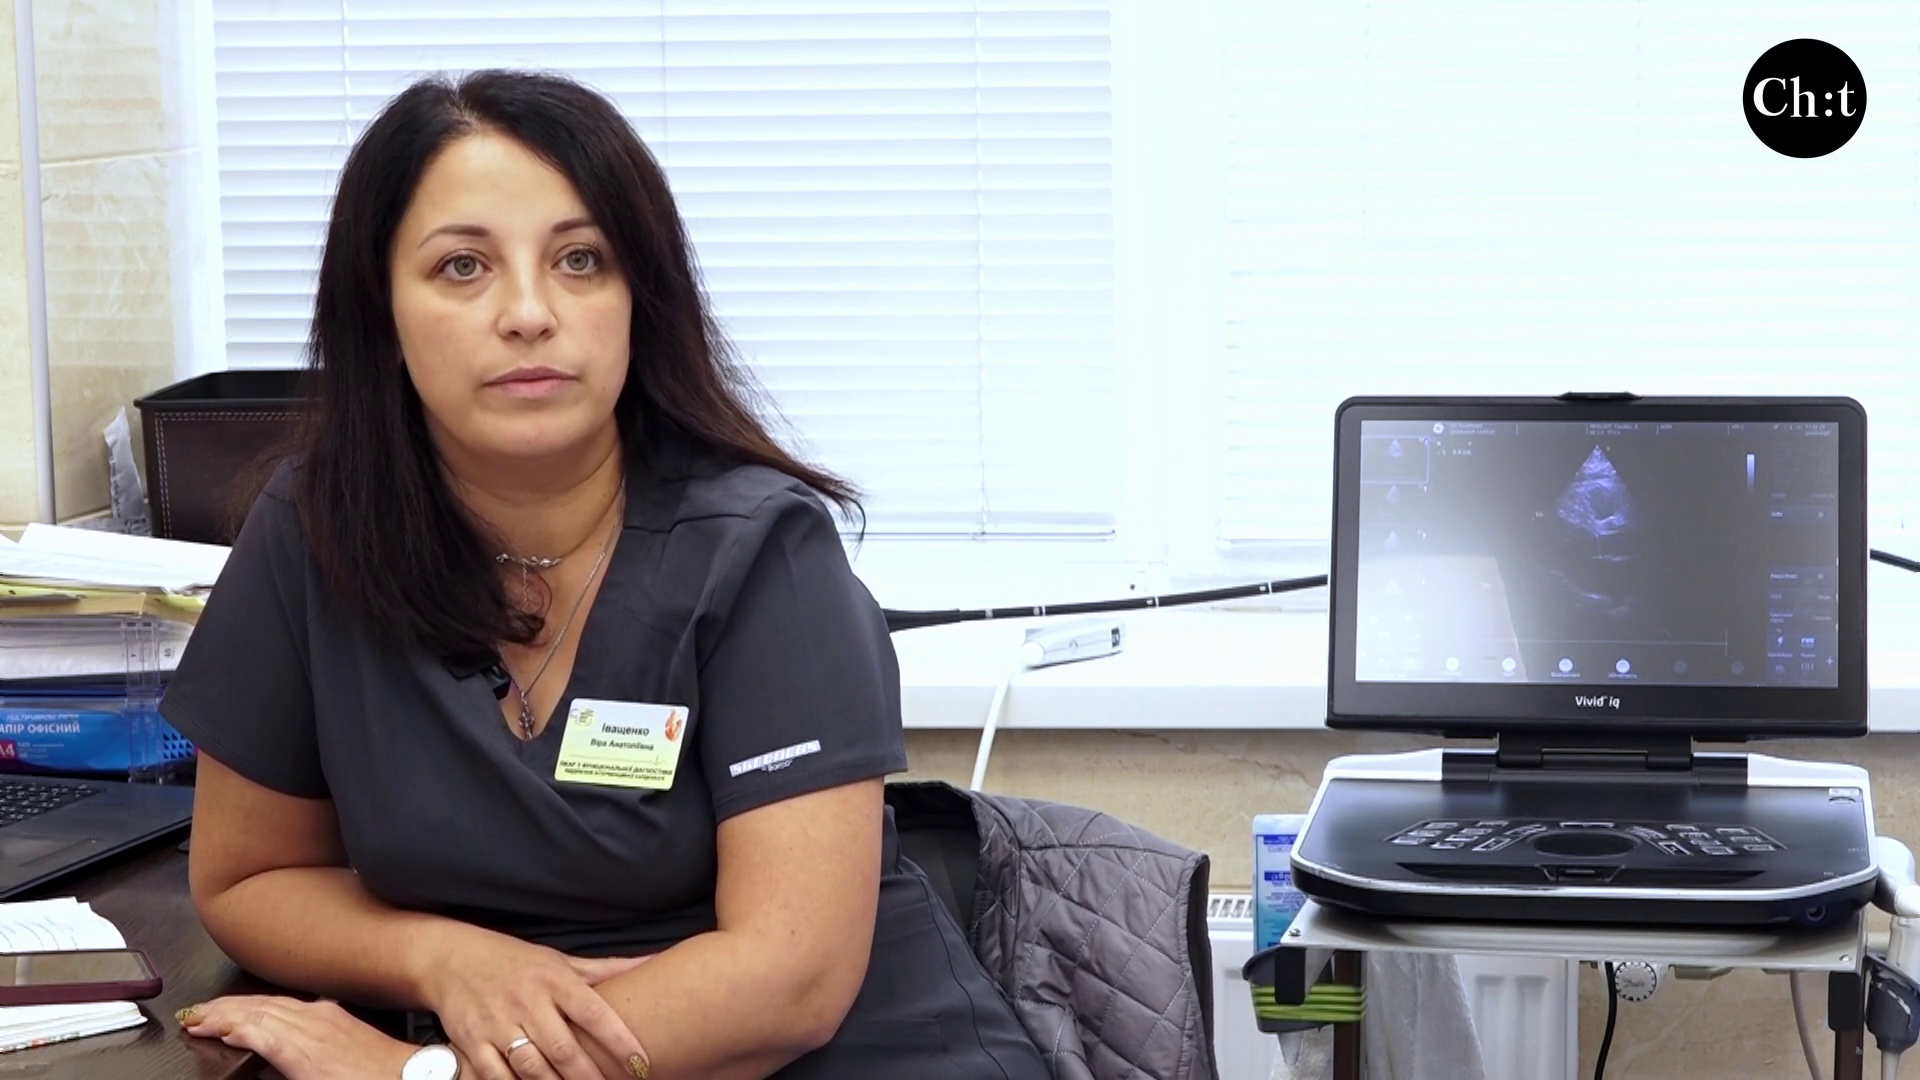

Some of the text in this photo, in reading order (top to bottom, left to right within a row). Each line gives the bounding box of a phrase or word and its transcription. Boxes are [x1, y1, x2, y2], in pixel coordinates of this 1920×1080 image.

[0, 720, 80, 733] АПІР ОФІСНИЙ
[602, 722, 650, 737] Іващенко
[590, 738, 607, 748] Віра
